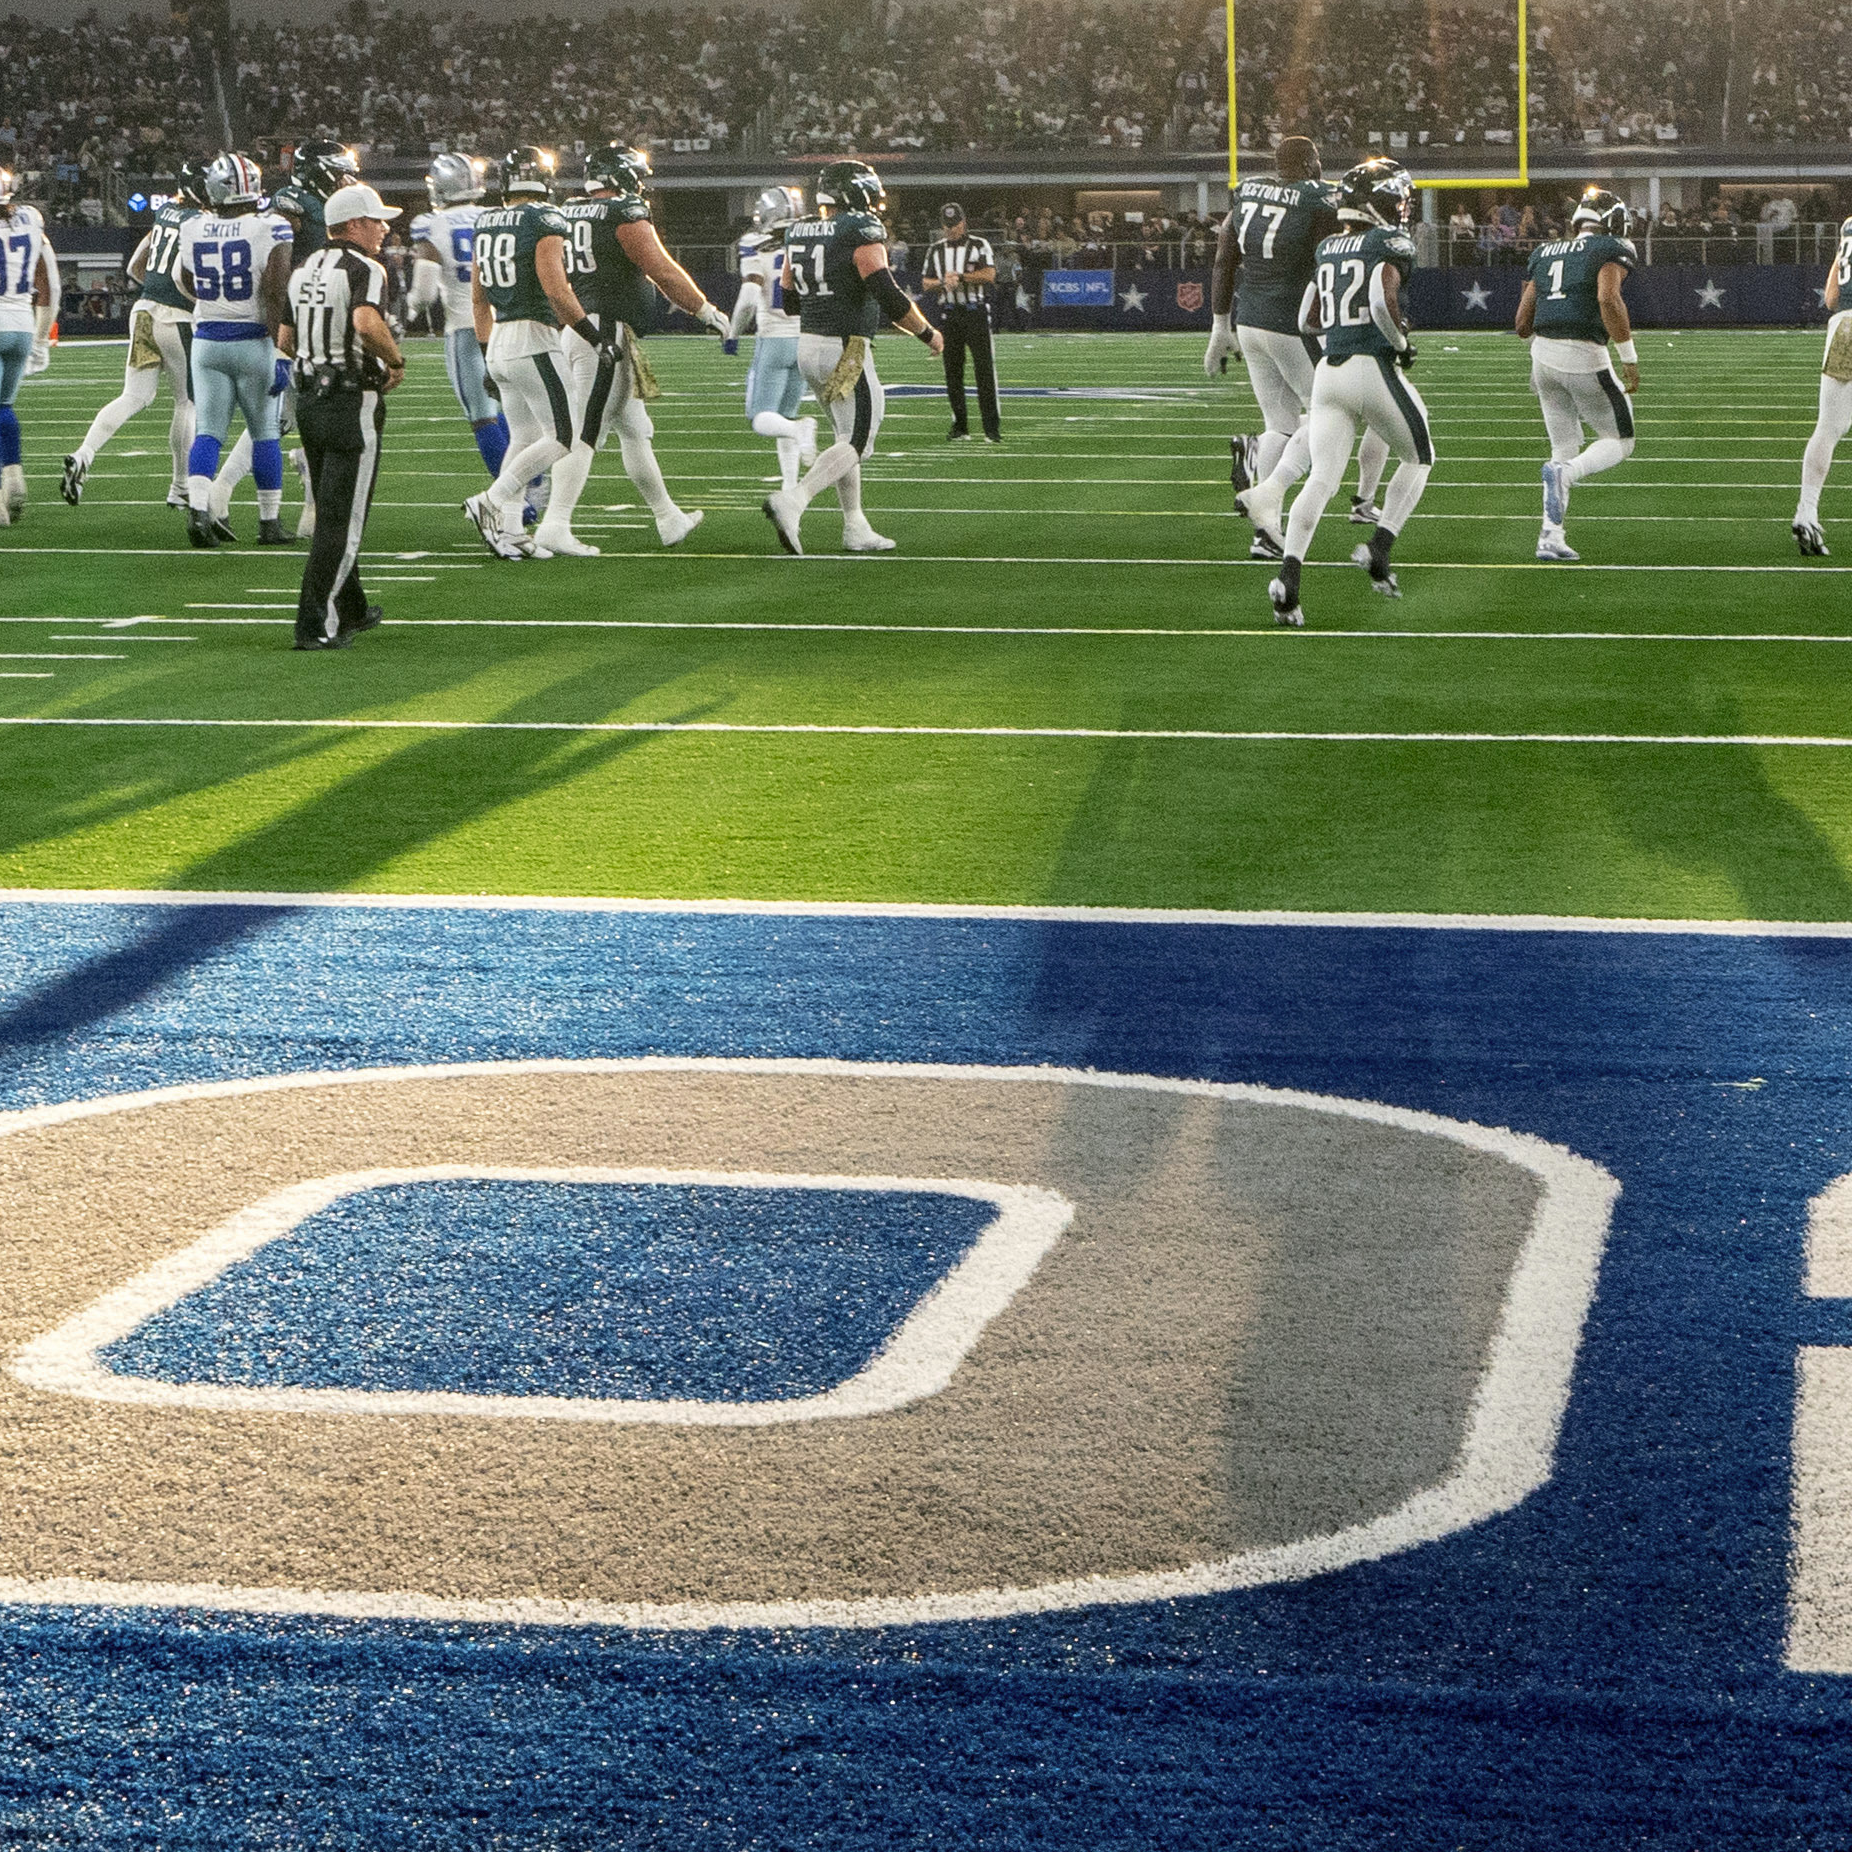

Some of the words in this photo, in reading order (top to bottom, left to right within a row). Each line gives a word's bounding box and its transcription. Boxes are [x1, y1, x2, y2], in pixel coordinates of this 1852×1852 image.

[203, 222, 241, 239] SMITH
[789, 220, 837, 238] JURGENS
[1237, 200, 1287, 260] 77
[1321, 234, 1365, 255] SMITH
[1541, 239, 1587, 257] HURTS
[193, 239, 253, 301] 58
[476, 233, 518, 288] 88
[787, 244, 835, 296] 51
[1546, 259, 1567, 300] 1
[1317, 259, 1371, 330] 82
